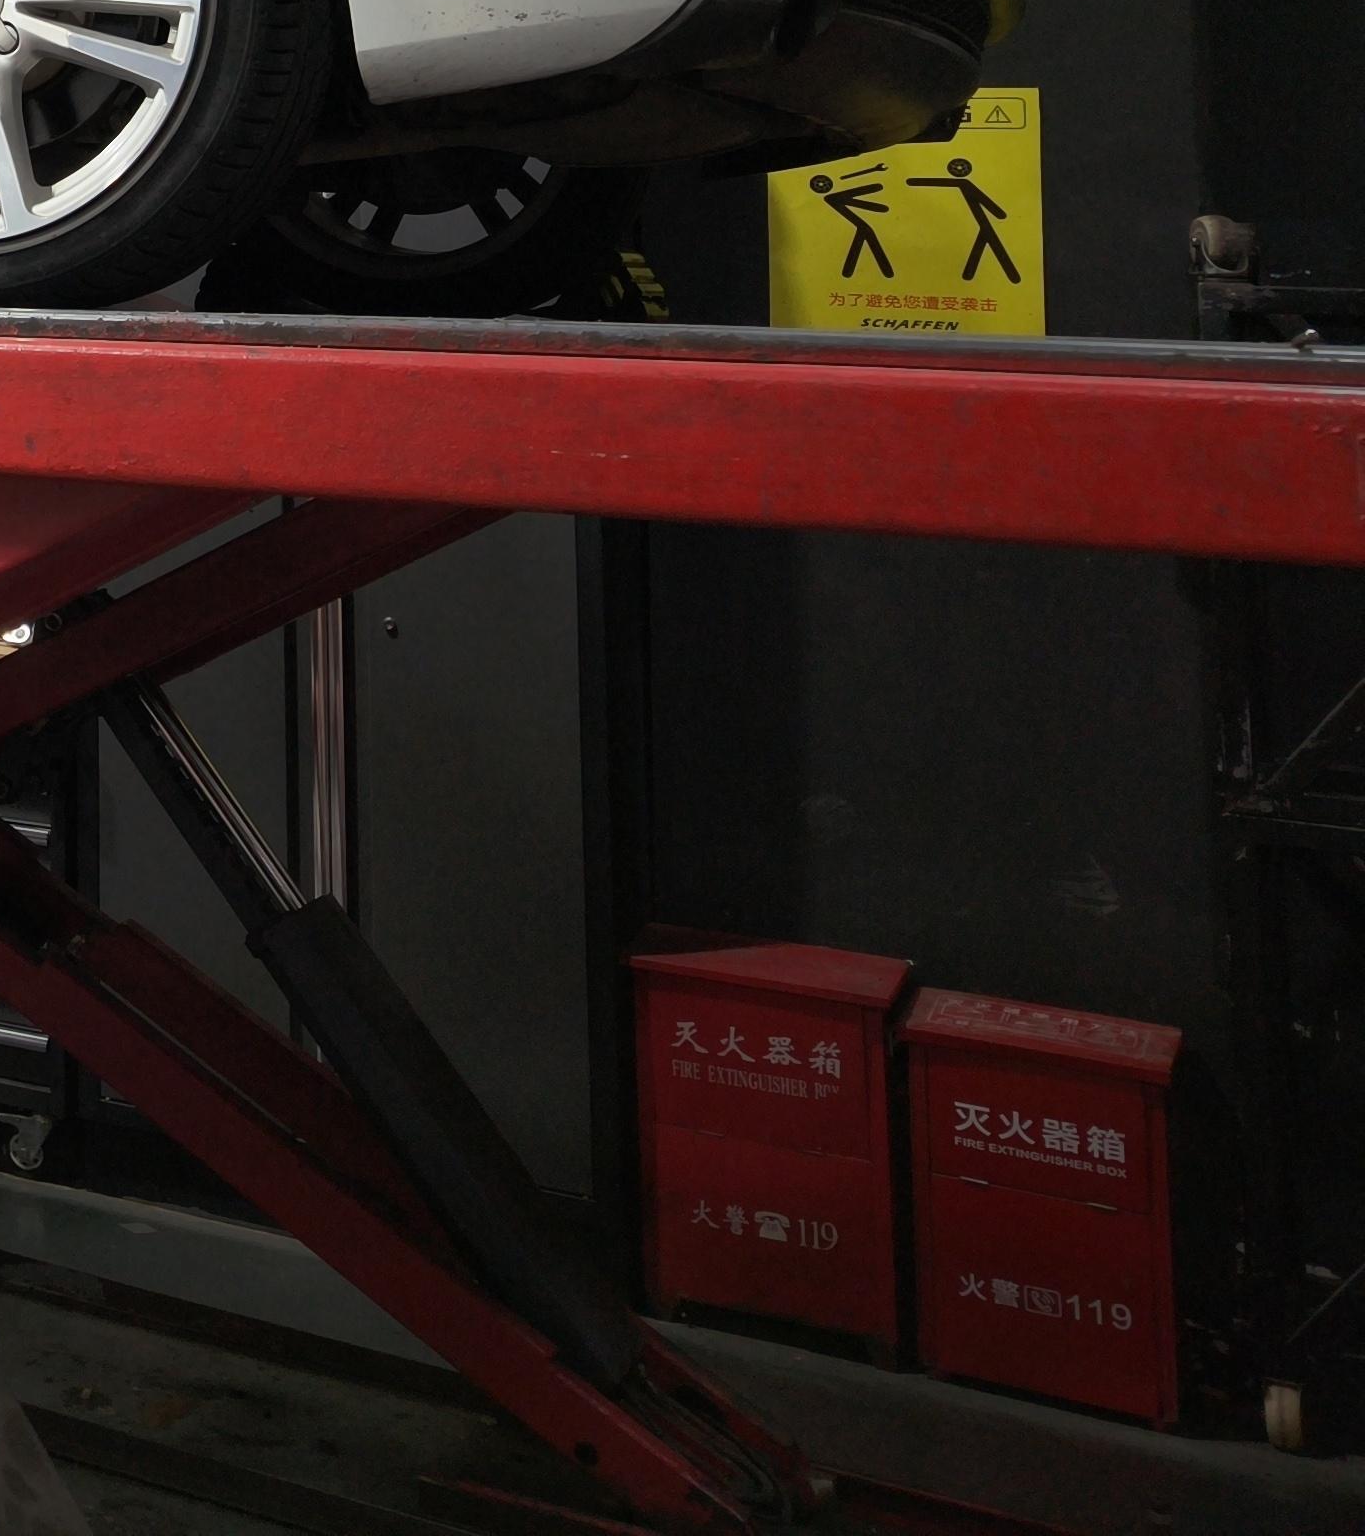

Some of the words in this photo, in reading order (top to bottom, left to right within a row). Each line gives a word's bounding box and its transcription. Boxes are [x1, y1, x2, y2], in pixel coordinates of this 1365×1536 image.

[828, 292, 999, 314] 为了避免您遭受袭击
[860, 317, 960, 332] SCHAFFEN
[670, 1021, 842, 1080] 灭火器箱
[671, 1059, 702, 1081] FIRE
[708, 1064, 809, 1099] EXTINGUISHER
[954, 1101, 1127, 1164] 灭火器箱
[954, 1136, 986, 1152] FIRE
[988, 1142, 1094, 1172] EXTINGUISHER
[1097, 1163, 1128, 1180] BOX
[691, 1199, 750, 1236] 火警
[798, 1217, 840, 1252] 119
[958, 1272, 1023, 1309] 火警
[1066, 1294, 1134, 1331] 119
